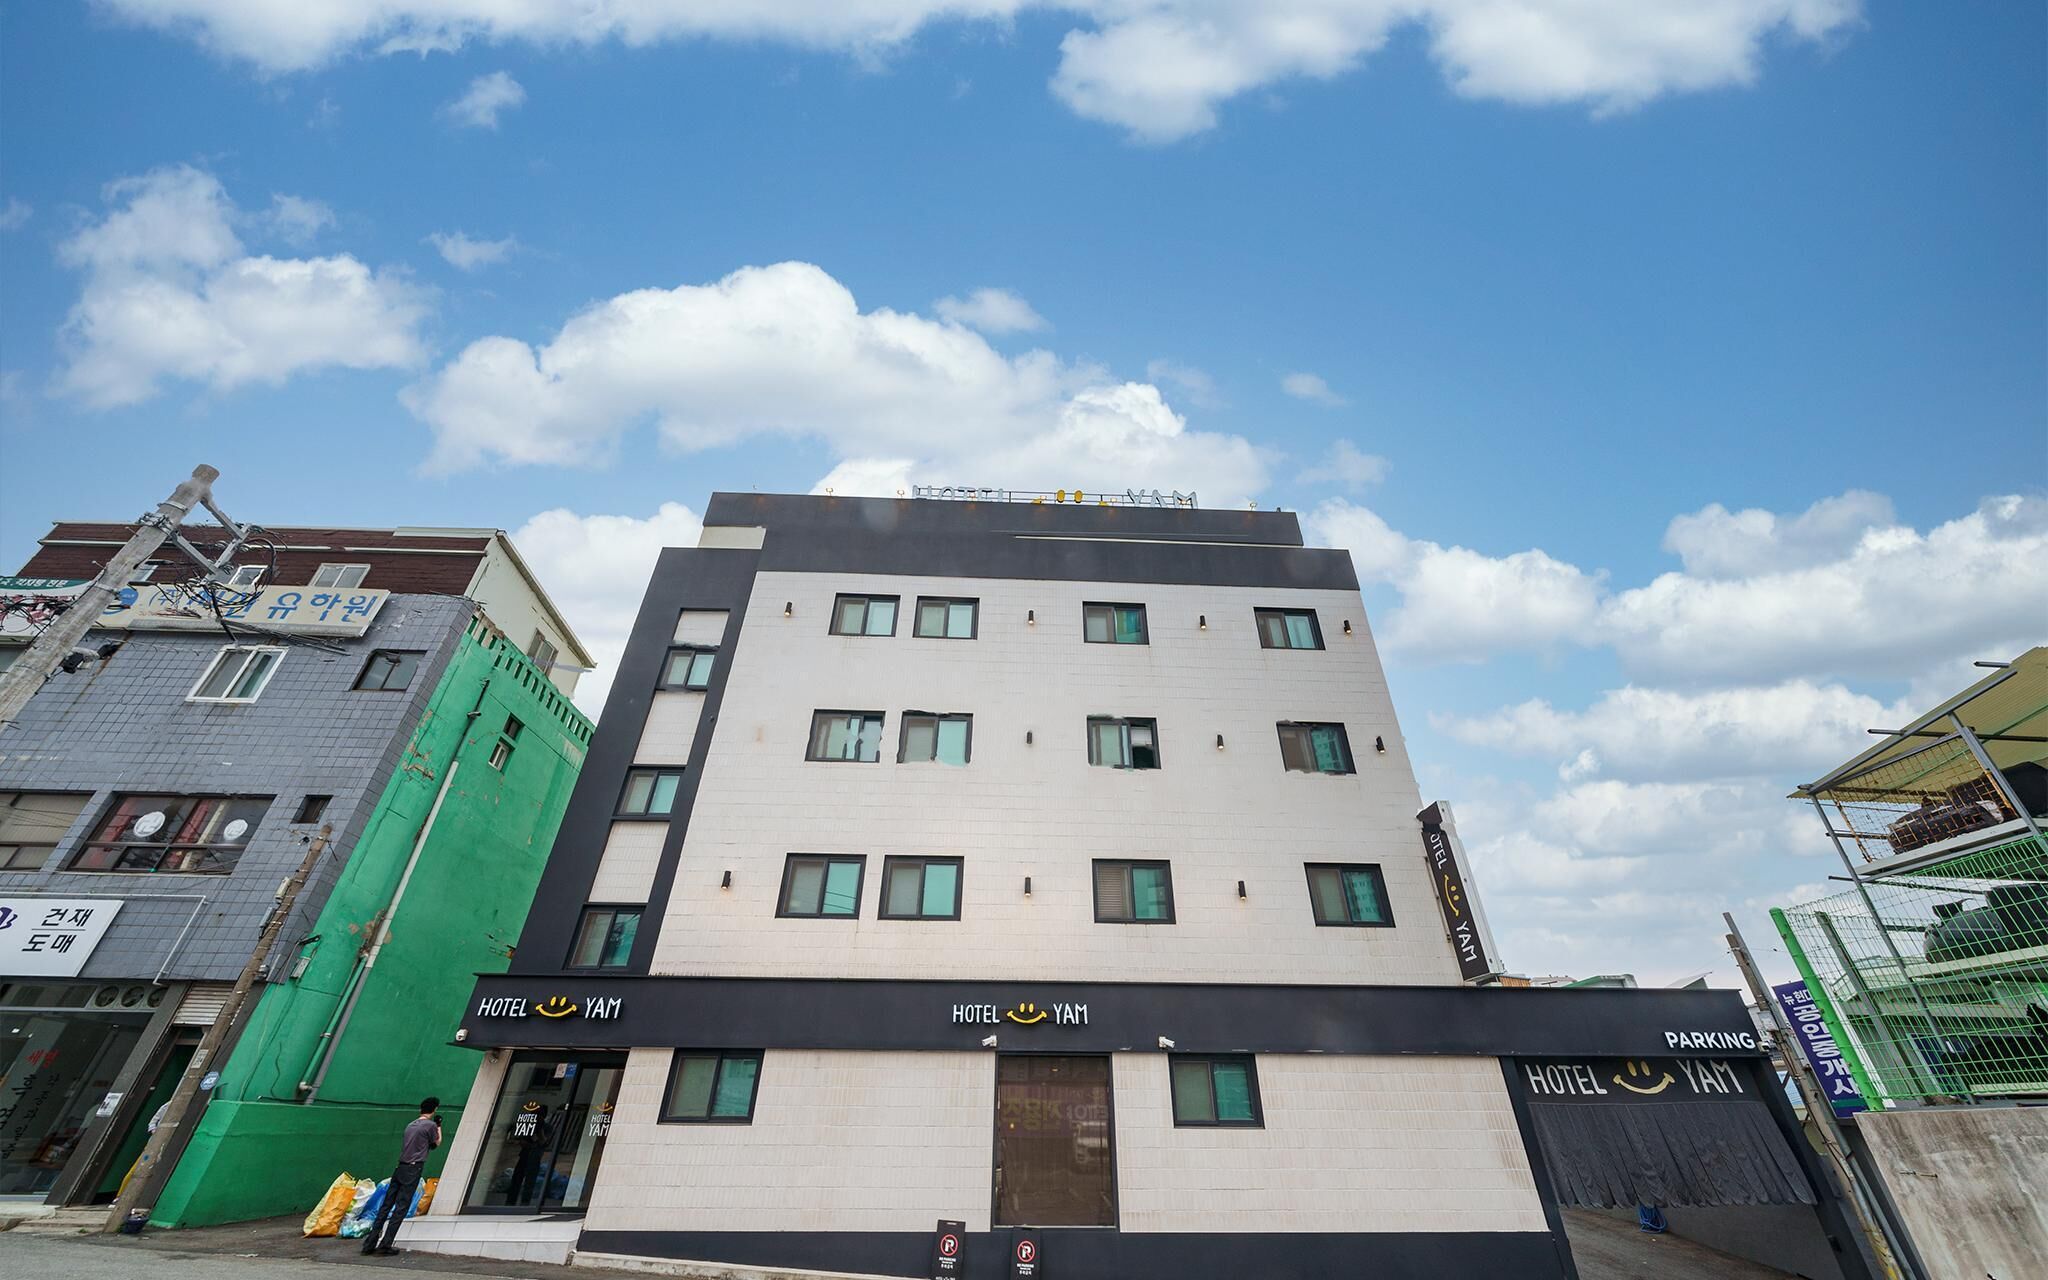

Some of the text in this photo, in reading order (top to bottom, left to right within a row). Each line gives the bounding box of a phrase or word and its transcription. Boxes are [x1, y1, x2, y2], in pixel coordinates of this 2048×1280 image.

[41, 908, 94, 927] 건재
[21, 934, 77, 953] 도매
[1456, 920, 1478, 962] YAM
[477, 997, 622, 1019] HOTEL YAM
[952, 1003, 1089, 1025] HOTEL YAM
[1664, 1031, 1756, 1049] PARKING
[1793, 1005, 1861, 1095] 공인중개사
[1525, 1059, 1744, 1095] HOTEL YAM
[517, 1113, 538, 1123] HOTEL
[591, 1114, 611, 1123] HOTEL
[514, 1122, 537, 1137] YAM
[588, 1123, 610, 1137] YAM
